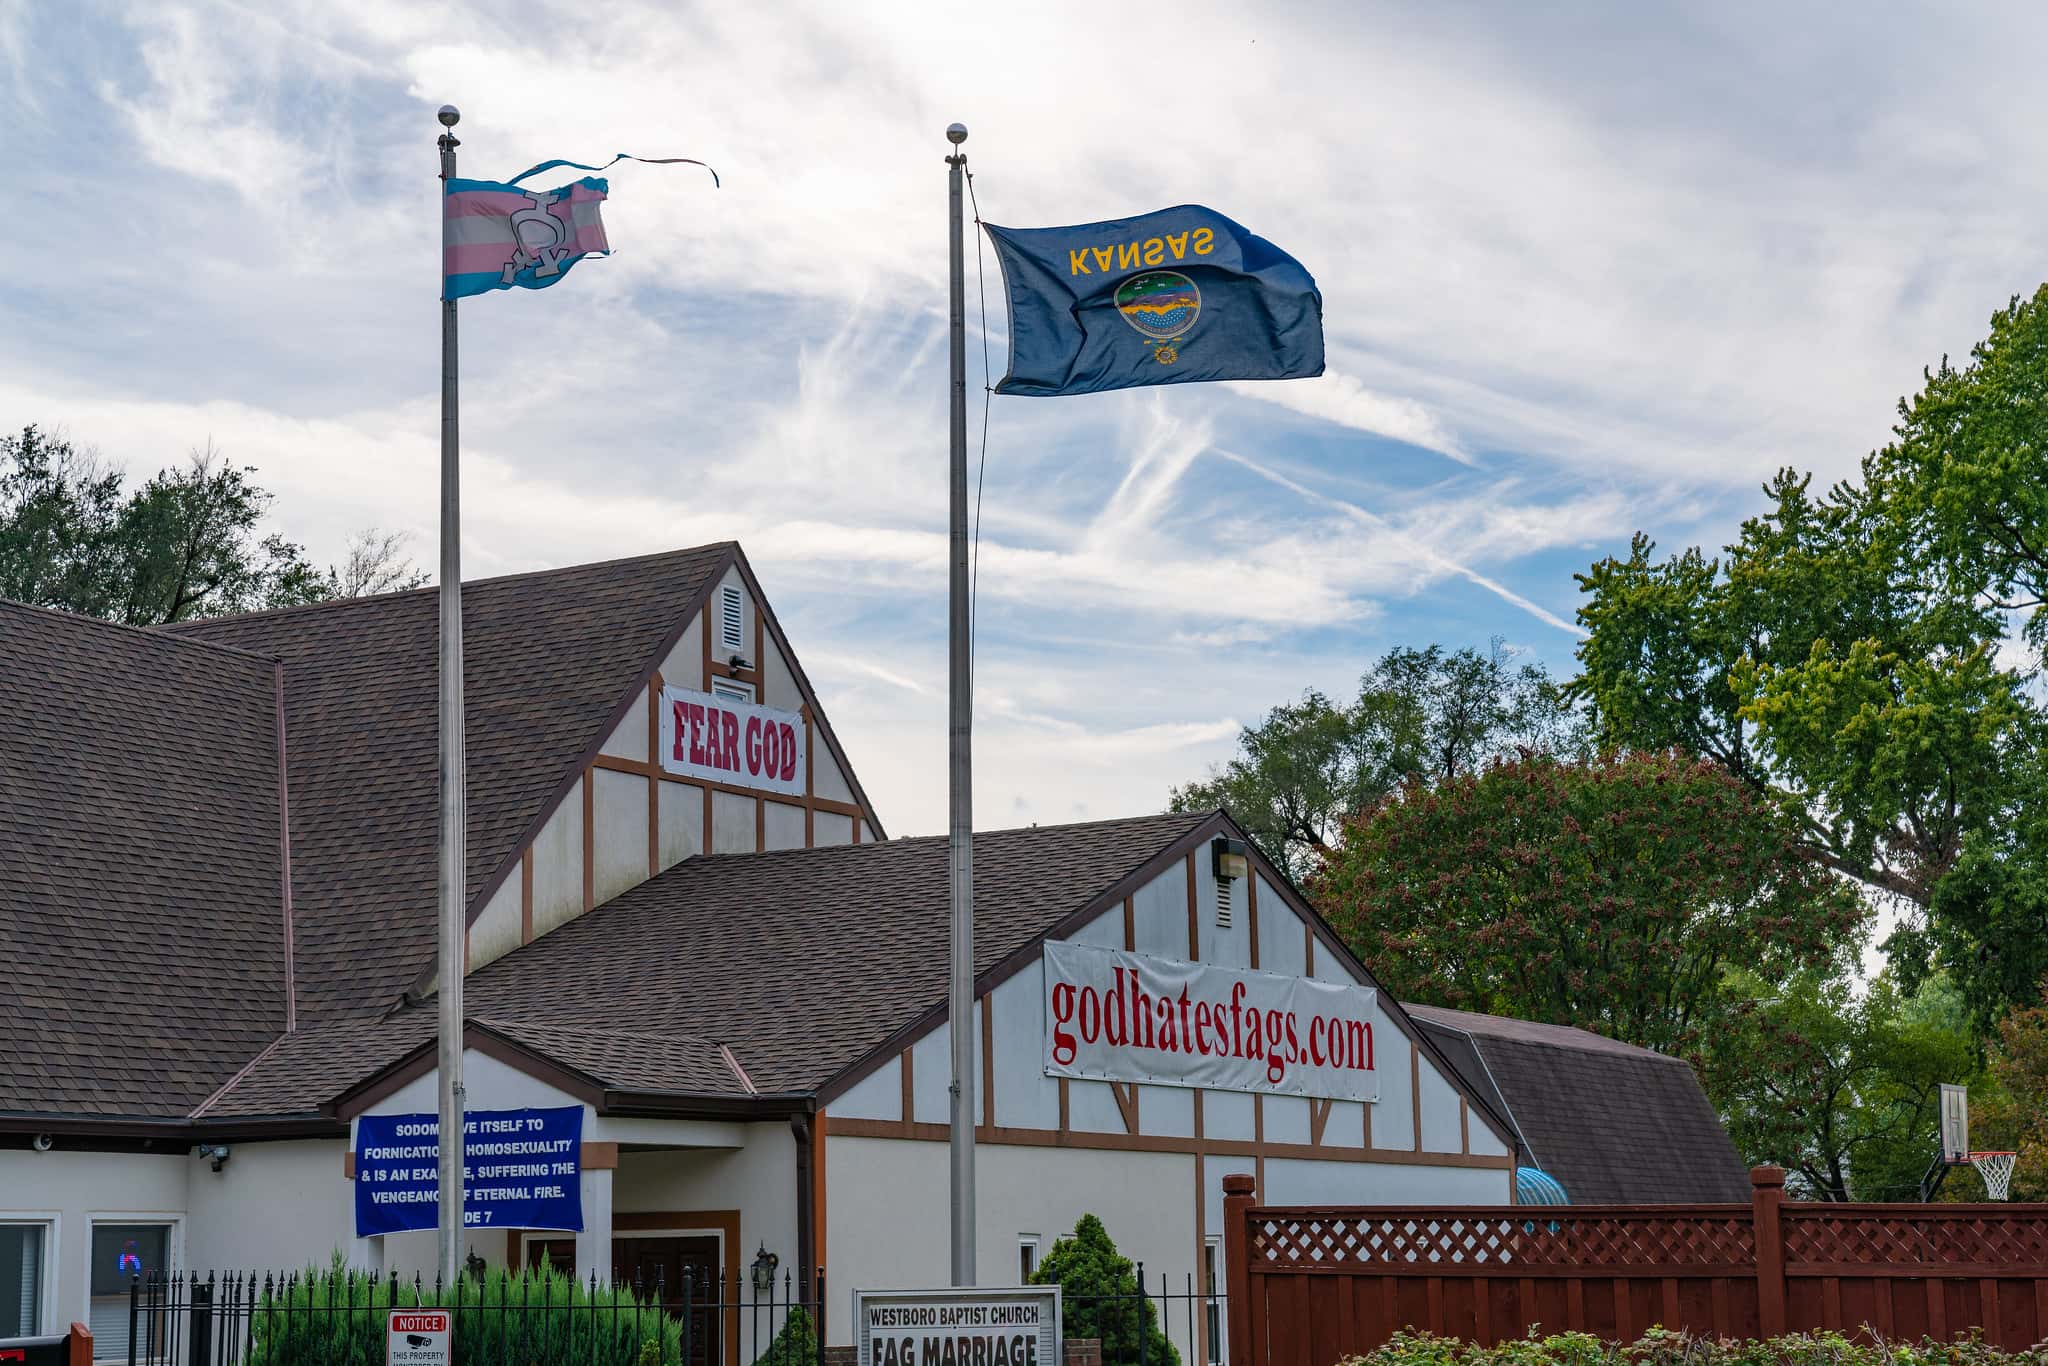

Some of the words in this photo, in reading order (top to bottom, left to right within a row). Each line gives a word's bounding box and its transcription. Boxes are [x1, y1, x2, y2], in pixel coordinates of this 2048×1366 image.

[673, 700, 740, 772] FEAR
[746, 715, 796, 781] GOD
[1052, 966, 1375, 1084] godhatesfags.com
[480, 1120, 523, 1133] ITSELF
[526, 1119, 544, 1131] TO
[364, 1146, 439, 1160] FORNICATIO
[466, 1140, 573, 1157] HOMOSEXUALITY
[361, 1170, 371, 1181] &
[374, 1169, 387, 1181] IS
[390, 1169, 409, 1181] AN
[412, 1167, 475, 1181] EXAE,
[478, 1164, 549, 1178] SUFFERING
[551, 1163, 575, 1175] THE
[372, 1190, 439, 1204] VENGEANC
[474, 1188, 531, 1201] ETERNAL
[534, 1186, 565, 1199] FIRE.
[484, 1210, 493, 1223] 7
[400, 1317, 439, 1330] NOTICE
[870, 1307, 936, 1326] WESTBORO
[940, 1306, 988, 1325] BAPTIST
[991, 1305, 1039, 1324] CHURCH
[393, 1352, 408, 1360] THIS
[410, 1351, 445, 1360] PROPERTY
[872, 1337, 915, 1366] FAG
[922, 1334, 1038, 1366] MARRIAGE
